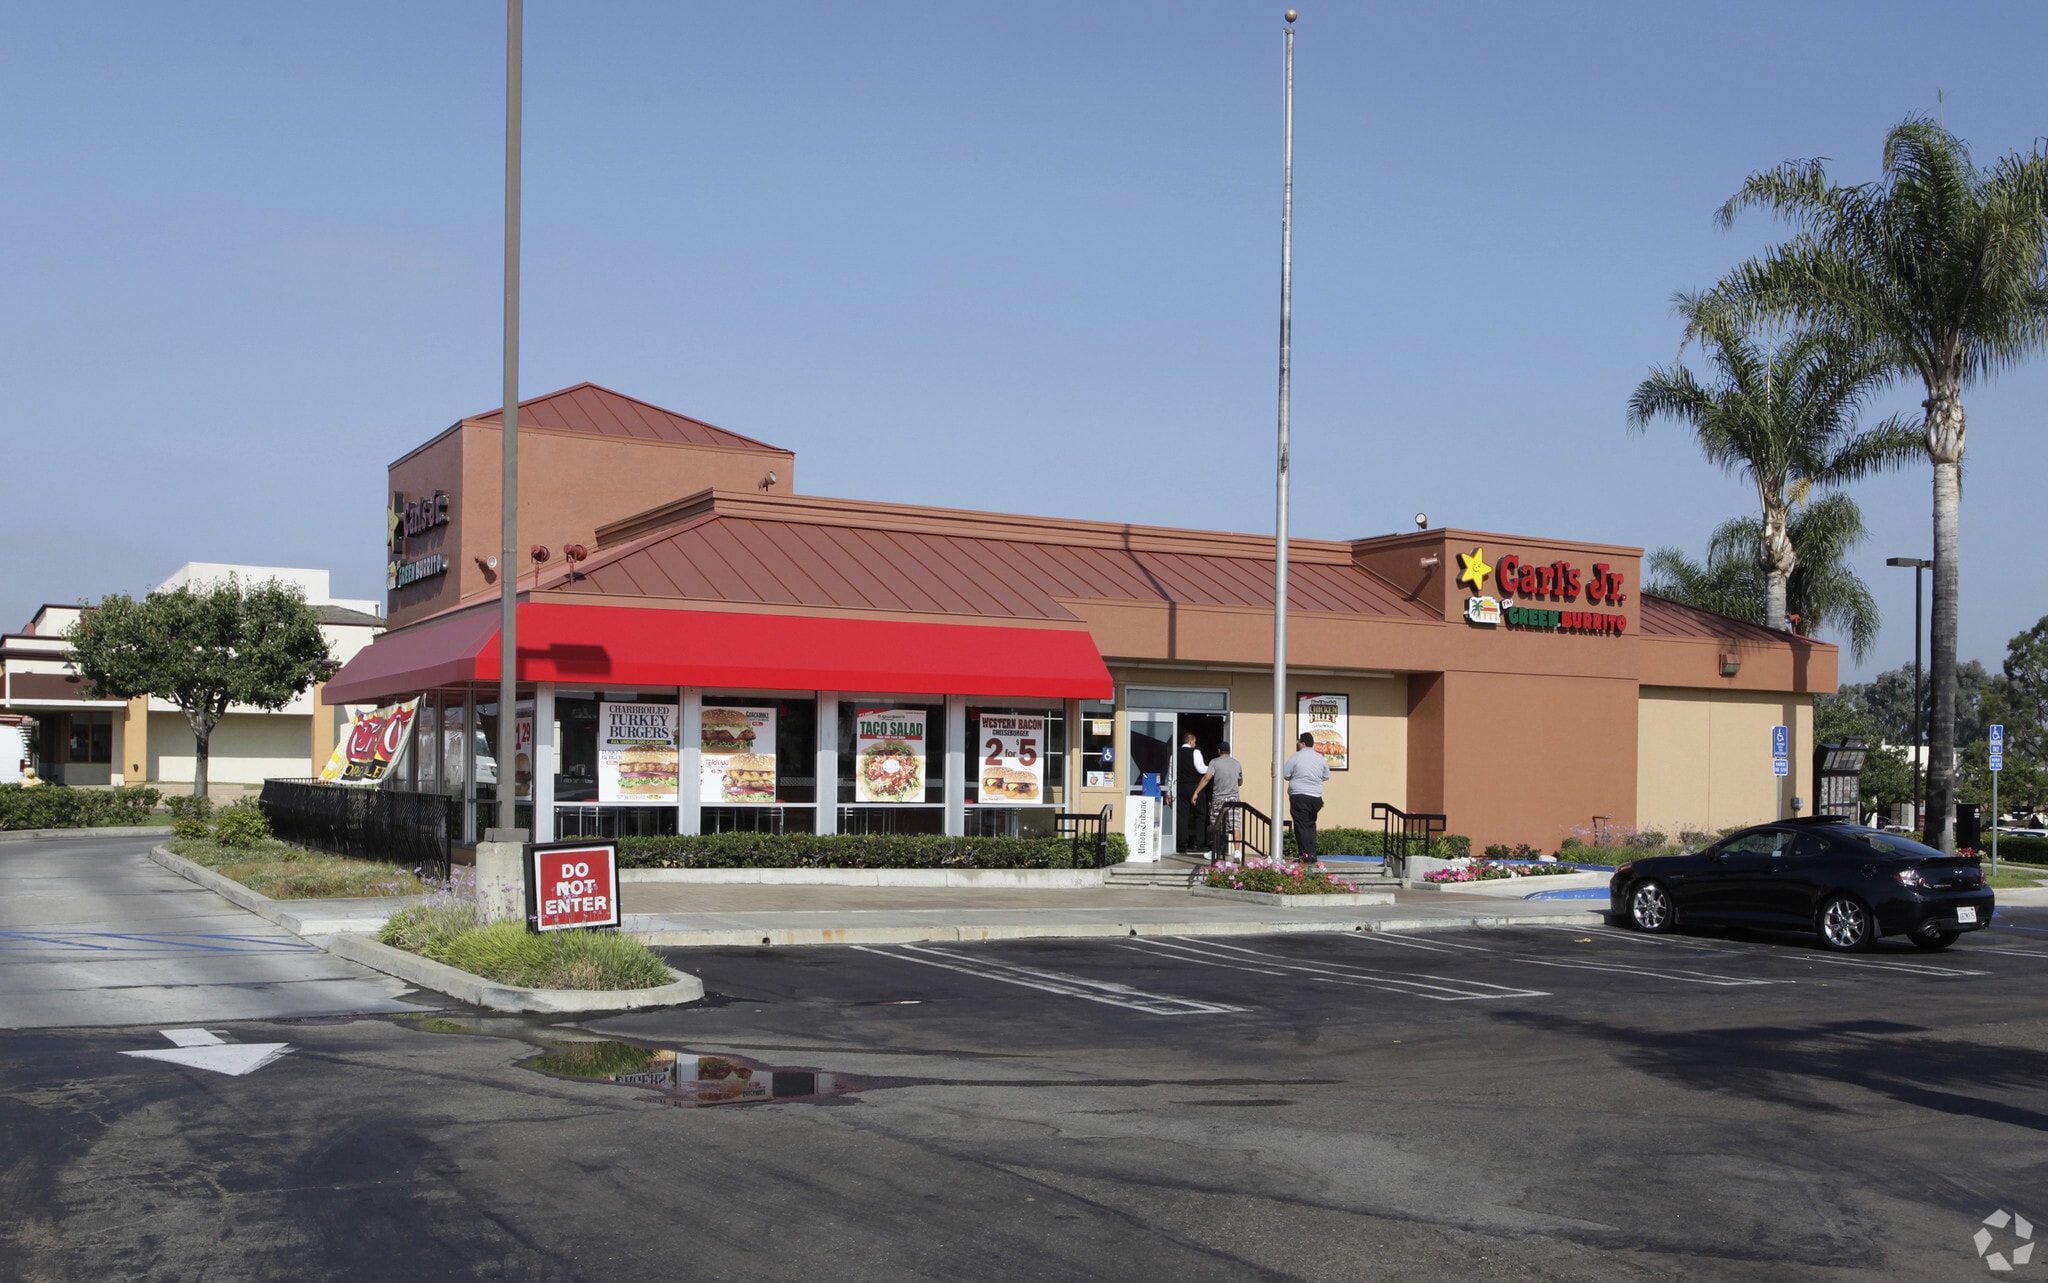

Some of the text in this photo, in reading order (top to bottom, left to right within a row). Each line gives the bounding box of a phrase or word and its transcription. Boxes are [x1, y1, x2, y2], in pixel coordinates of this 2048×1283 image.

[399, 553, 441, 585] GREEN BURRITO
[1500, 554, 1627, 601] Carl's Jr.
[1508, 607, 1627, 632] GREEN BURRITO
[609, 705, 670, 715] CHARBROILED
[1309, 705, 1338, 714] CHICKEN
[609, 714, 669, 726] TURKEY
[982, 718, 1042, 729] WESTERN BACON
[1309, 713, 1337, 723] FILLET
[610, 726, 669, 738] BURGERS
[860, 721, 923, 736] TACO SALAD
[985, 738, 1003, 765] 2
[1005, 749, 1016, 757] for
[562, 863, 589, 879] DO
[556, 880, 596, 896] NOT
[546, 896, 607, 915] ENTER
